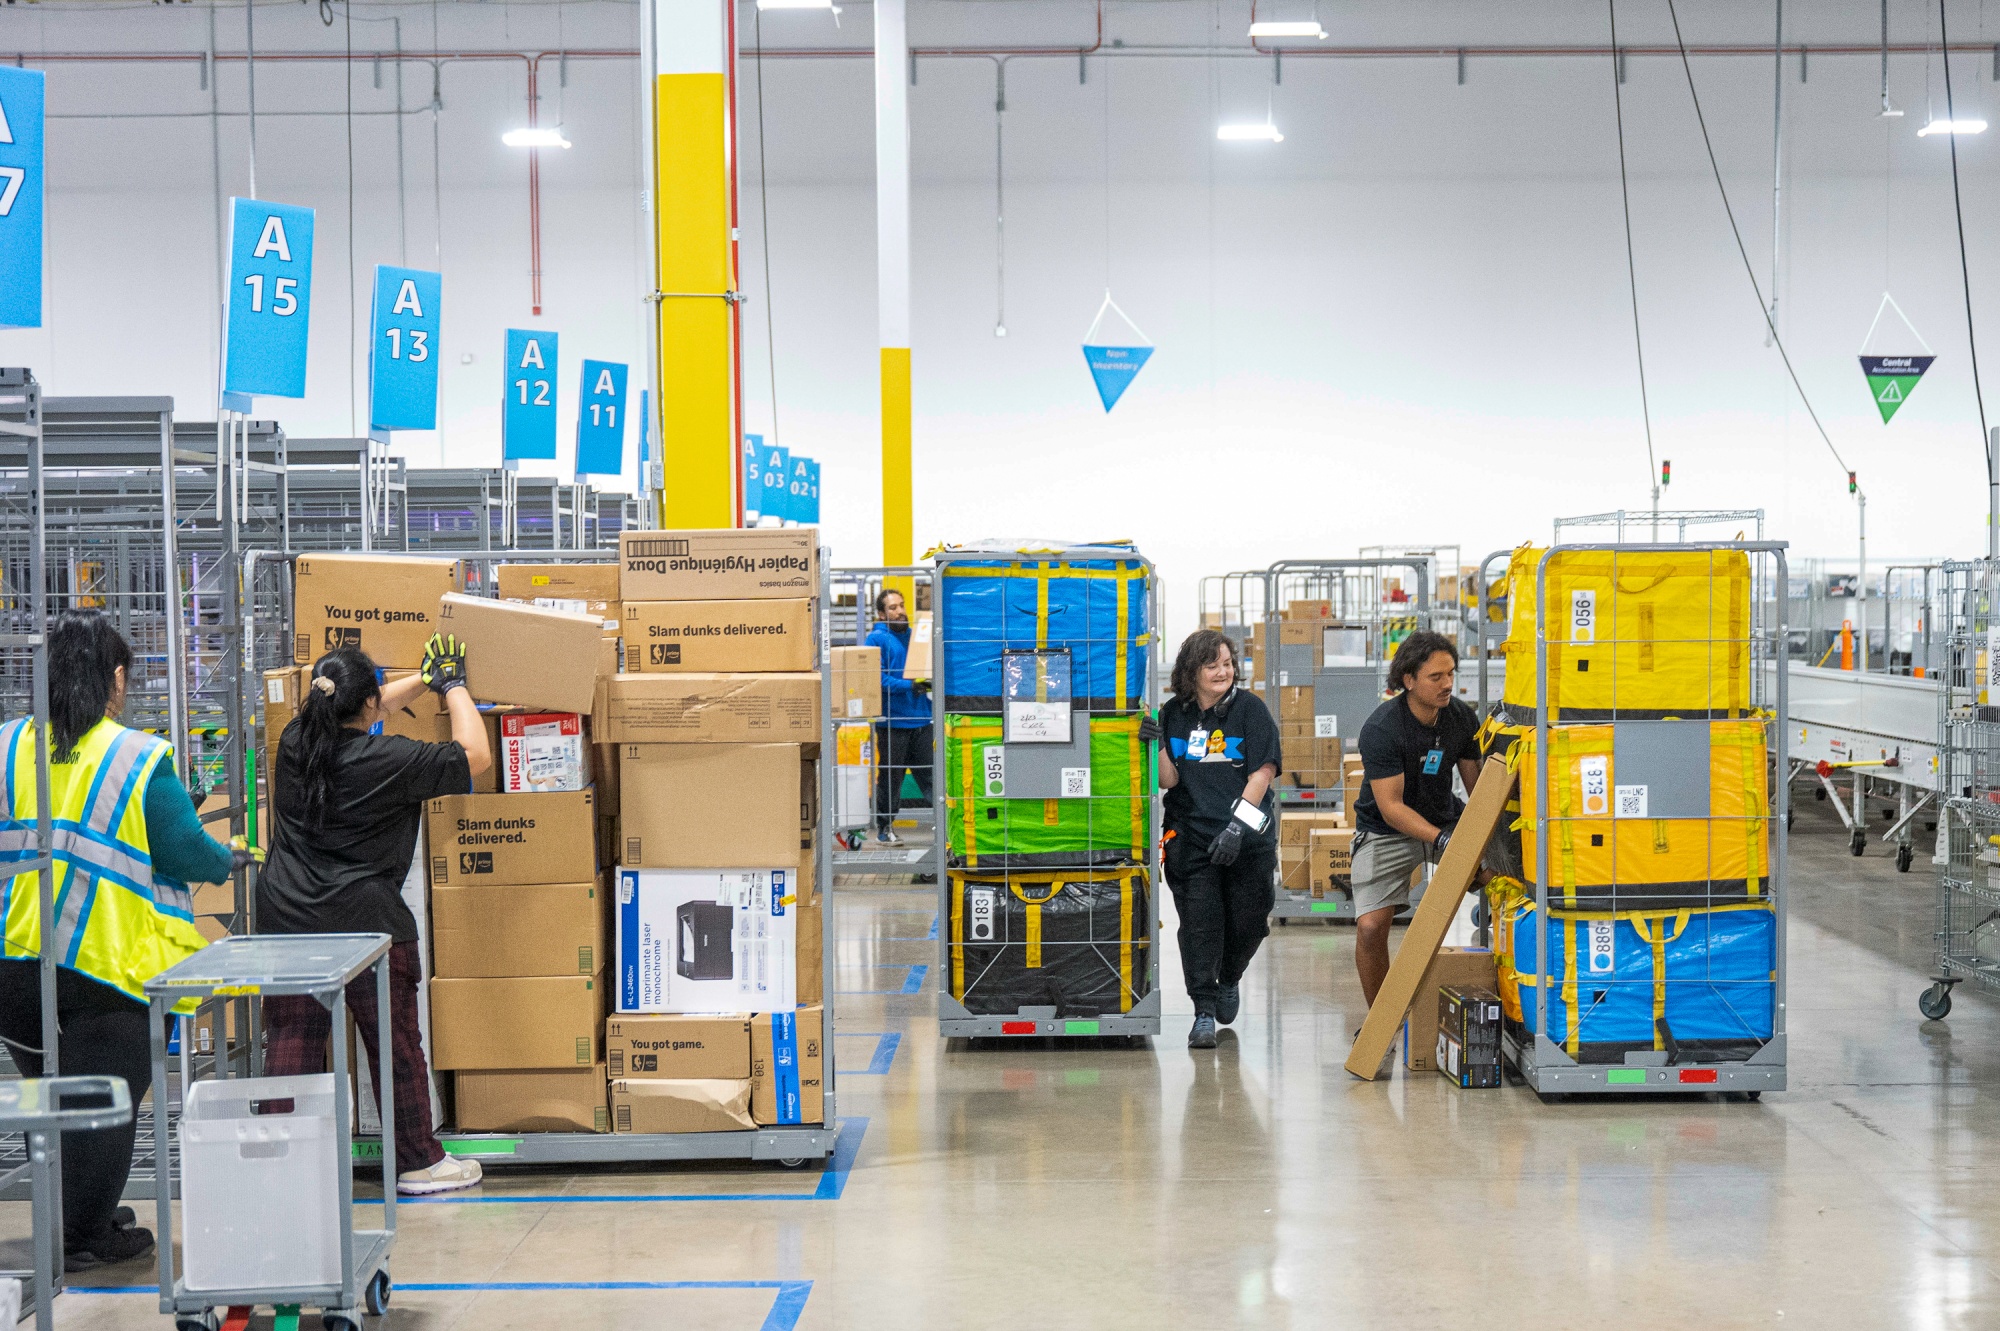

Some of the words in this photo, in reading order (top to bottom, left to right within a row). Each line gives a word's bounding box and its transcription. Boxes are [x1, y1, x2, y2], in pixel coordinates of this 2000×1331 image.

[253, 216, 292, 262] A
[244, 274, 299, 316] 15
[392, 279, 424, 317] A
[386, 328, 428, 363] 13
[519, 339, 545, 369] A
[1882, 358, 1912, 367] Central
[594, 369, 615, 396] A
[515, 380, 550, 406] 12
[589, 404, 616, 428] 11
[745, 439, 756, 457] A
[769, 450, 782, 468] A
[794, 461, 807, 477] A
[764, 472, 785, 488] 03
[790, 481, 809, 496] 02
[628, 560, 667, 574] Doux
[670, 556, 755, 573] Hygiénique
[758, 555, 809, 573] Papier
[782, 580, 809, 588] amazon
[325, 605, 351, 620] You
[353, 607, 381, 623] got
[384, 610, 429, 624] game.
[1575, 599, 1591, 627] 056
[649, 625, 681, 637] Slam
[682, 623, 721, 636] dunks
[723, 622, 787, 636] delivered.
[509, 739, 521, 791] HUGGIES
[987, 755, 1002, 779] 954
[1632, 787, 1644, 796] LNC
[457, 817, 491, 830] Slam
[493, 817, 535, 830] dunks
[457, 831, 527, 845] delivered.
[975, 898, 989, 922] 183
[643, 922, 651, 946] laser
[1595, 926, 1611, 953] 886
[643, 948, 653, 1005] Imprimante
[653, 939, 661, 1005] monochrome
[631, 1039, 650, 1050] You
[652, 1040, 670, 1051] got
[671, 1041, 705, 1051] game.
[754, 1058, 765, 1077] 130
